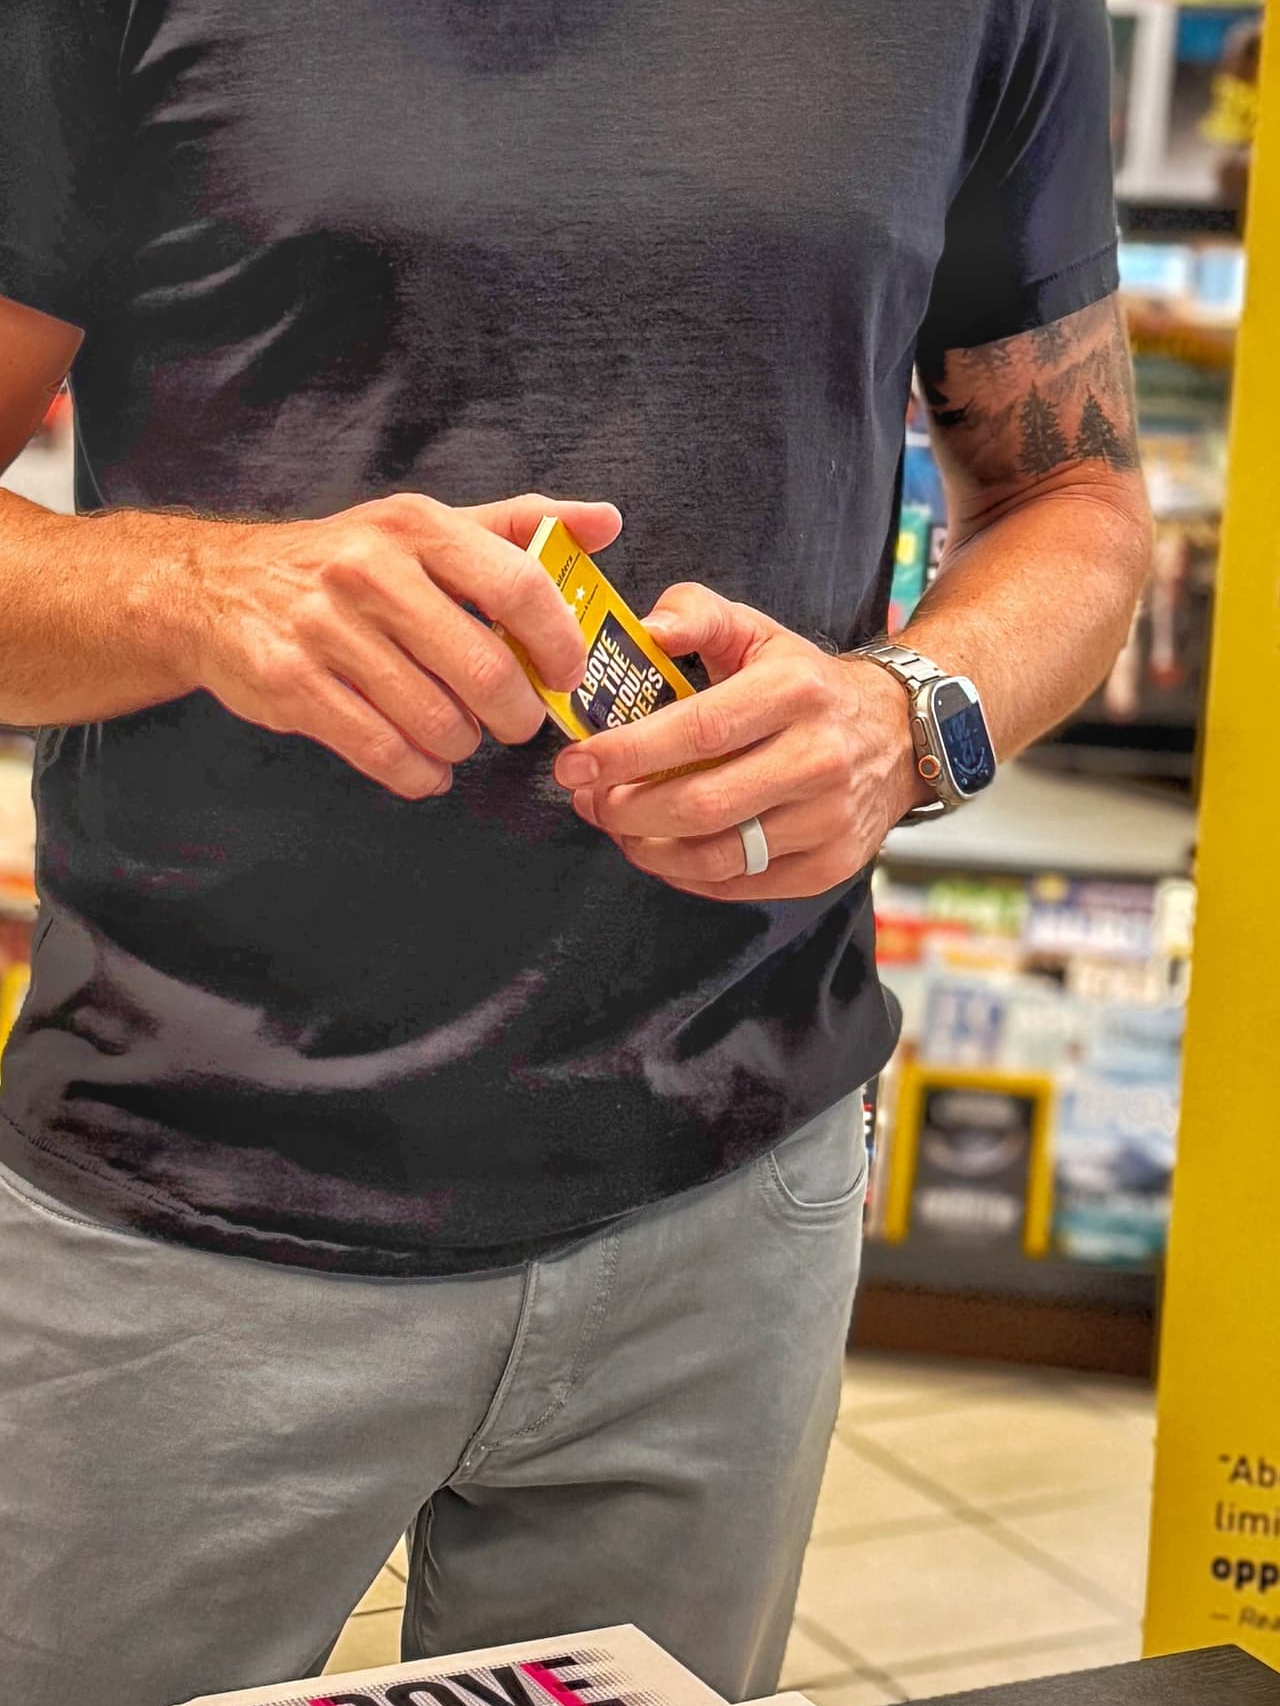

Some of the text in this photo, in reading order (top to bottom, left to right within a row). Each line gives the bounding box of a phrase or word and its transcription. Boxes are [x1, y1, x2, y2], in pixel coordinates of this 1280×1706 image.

[577, 629, 618, 711] ABOVE
[601, 645, 631, 695] THE
[606, 663, 647, 729] SHOUL
